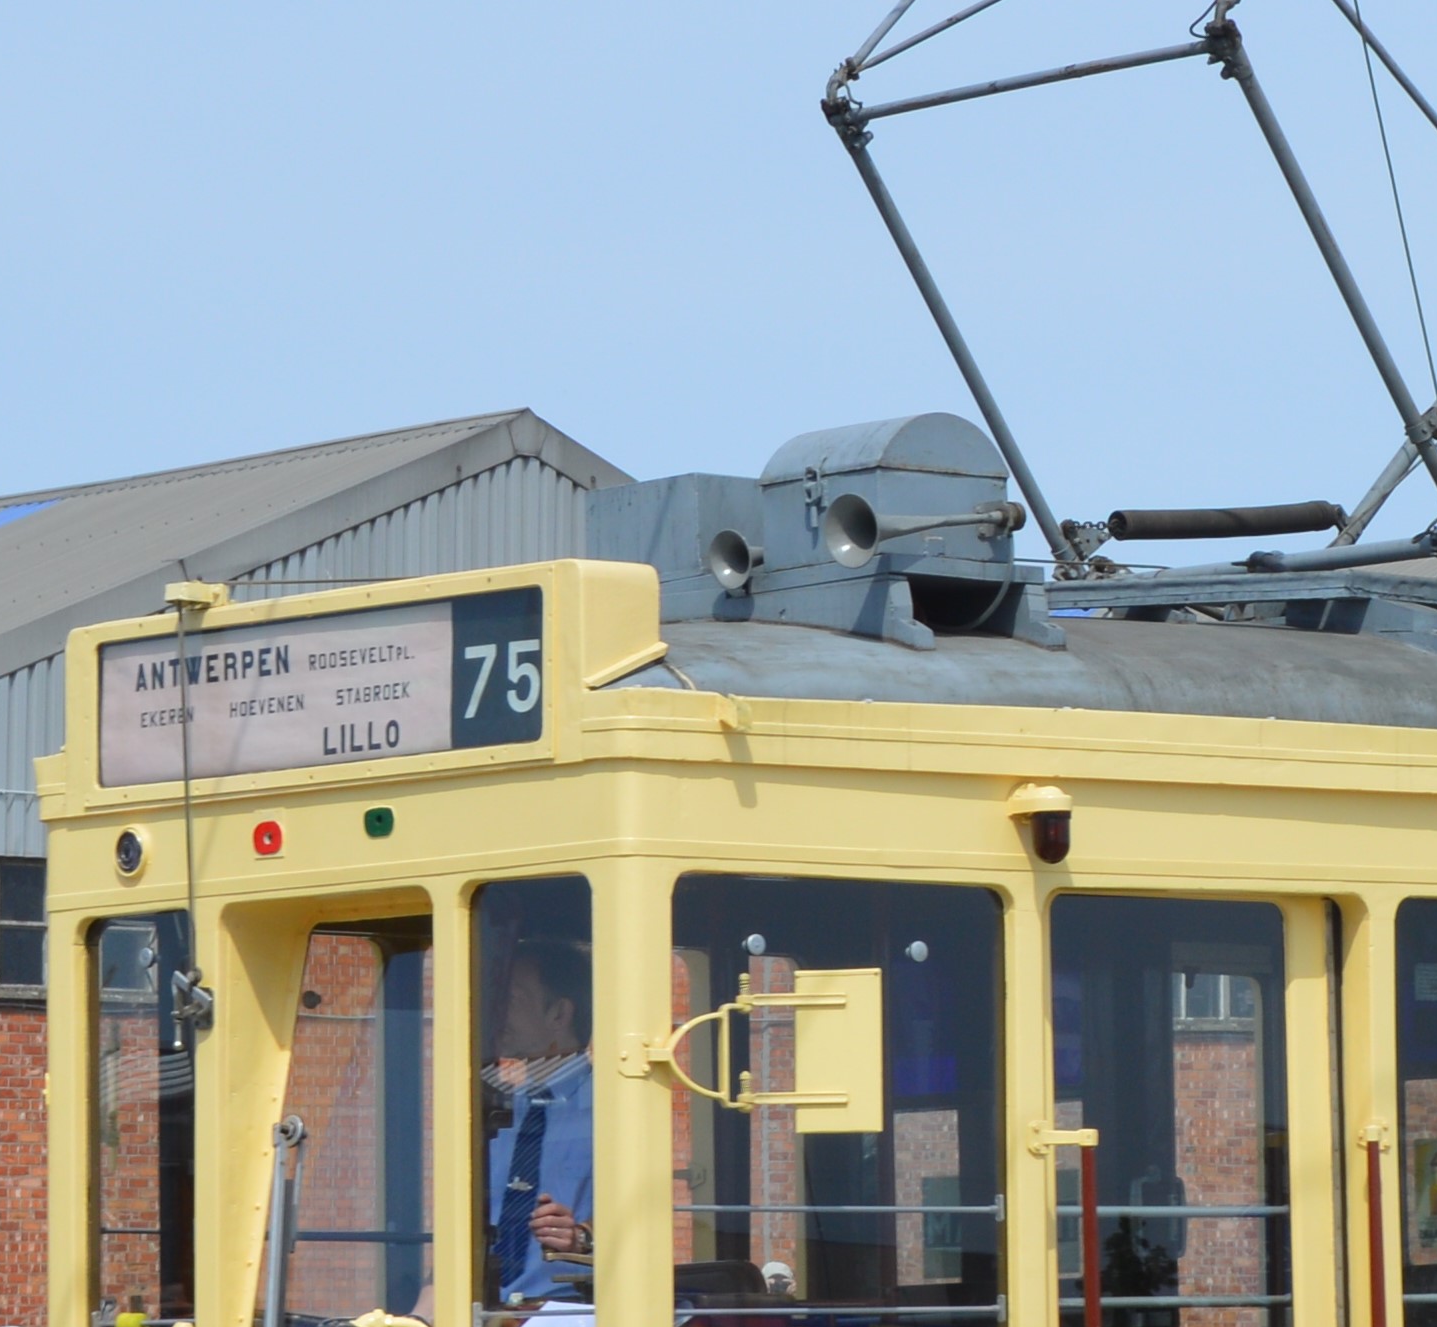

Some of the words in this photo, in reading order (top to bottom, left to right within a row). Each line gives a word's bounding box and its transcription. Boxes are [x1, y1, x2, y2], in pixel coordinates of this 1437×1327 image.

[135, 645, 290, 692] ANTWERPEN
[464, 639, 541, 719] 75
[229, 694, 306, 718] HOEVENEN
[335, 681, 411, 706] STABROEK
[323, 719, 400, 756] LILLO
